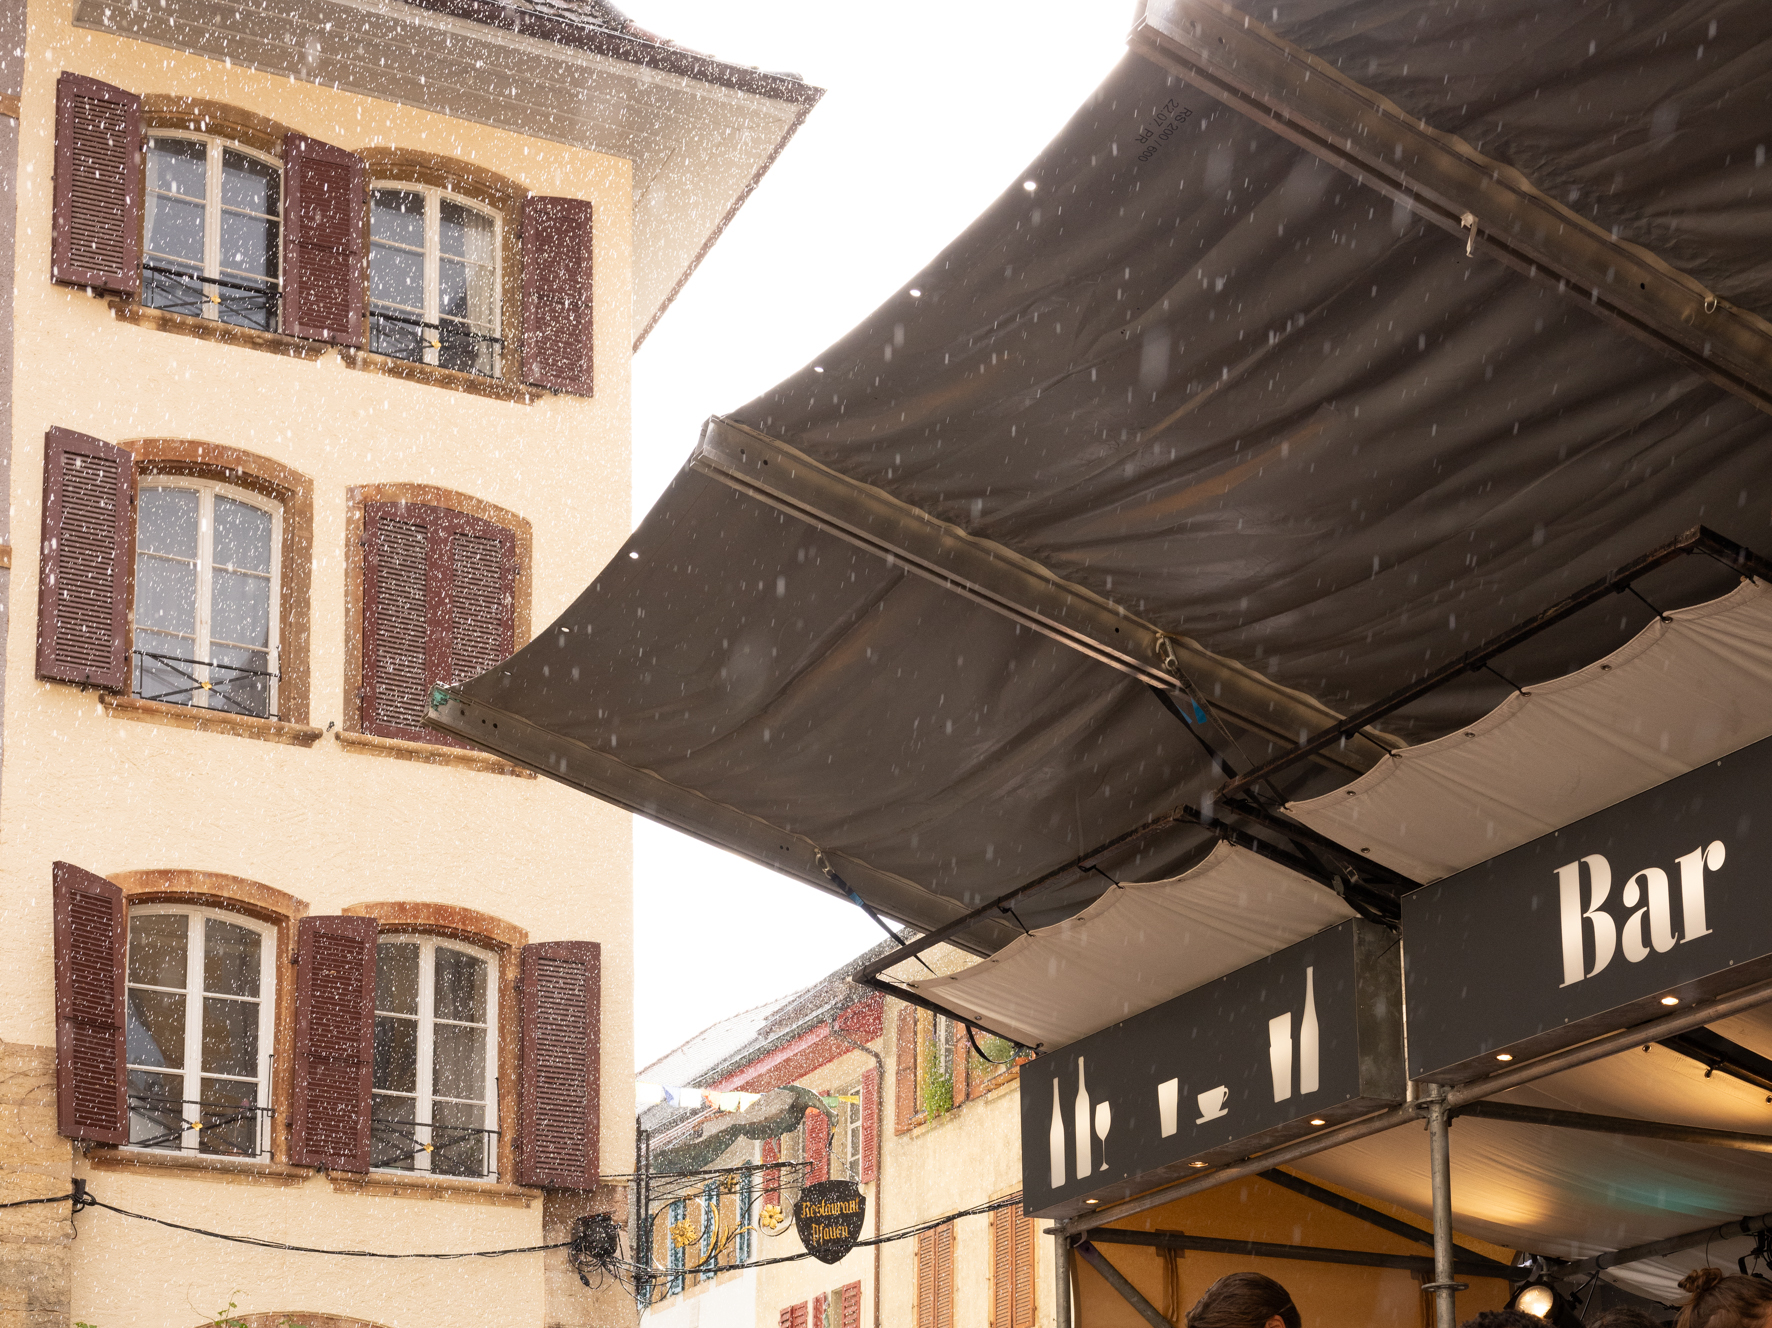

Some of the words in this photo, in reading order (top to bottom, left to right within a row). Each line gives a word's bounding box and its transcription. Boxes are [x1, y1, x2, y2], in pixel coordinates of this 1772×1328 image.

[1175, 107, 1193, 123] RS
[1135, 128, 1154, 144] PR
[1158, 122, 1179, 141] 200
[1137, 145, 1158, 162] 600
[1553, 839, 1726, 989] Bar
[800, 1197, 860, 1219] Restaurant
[811, 1223, 849, 1246] Pfauen
